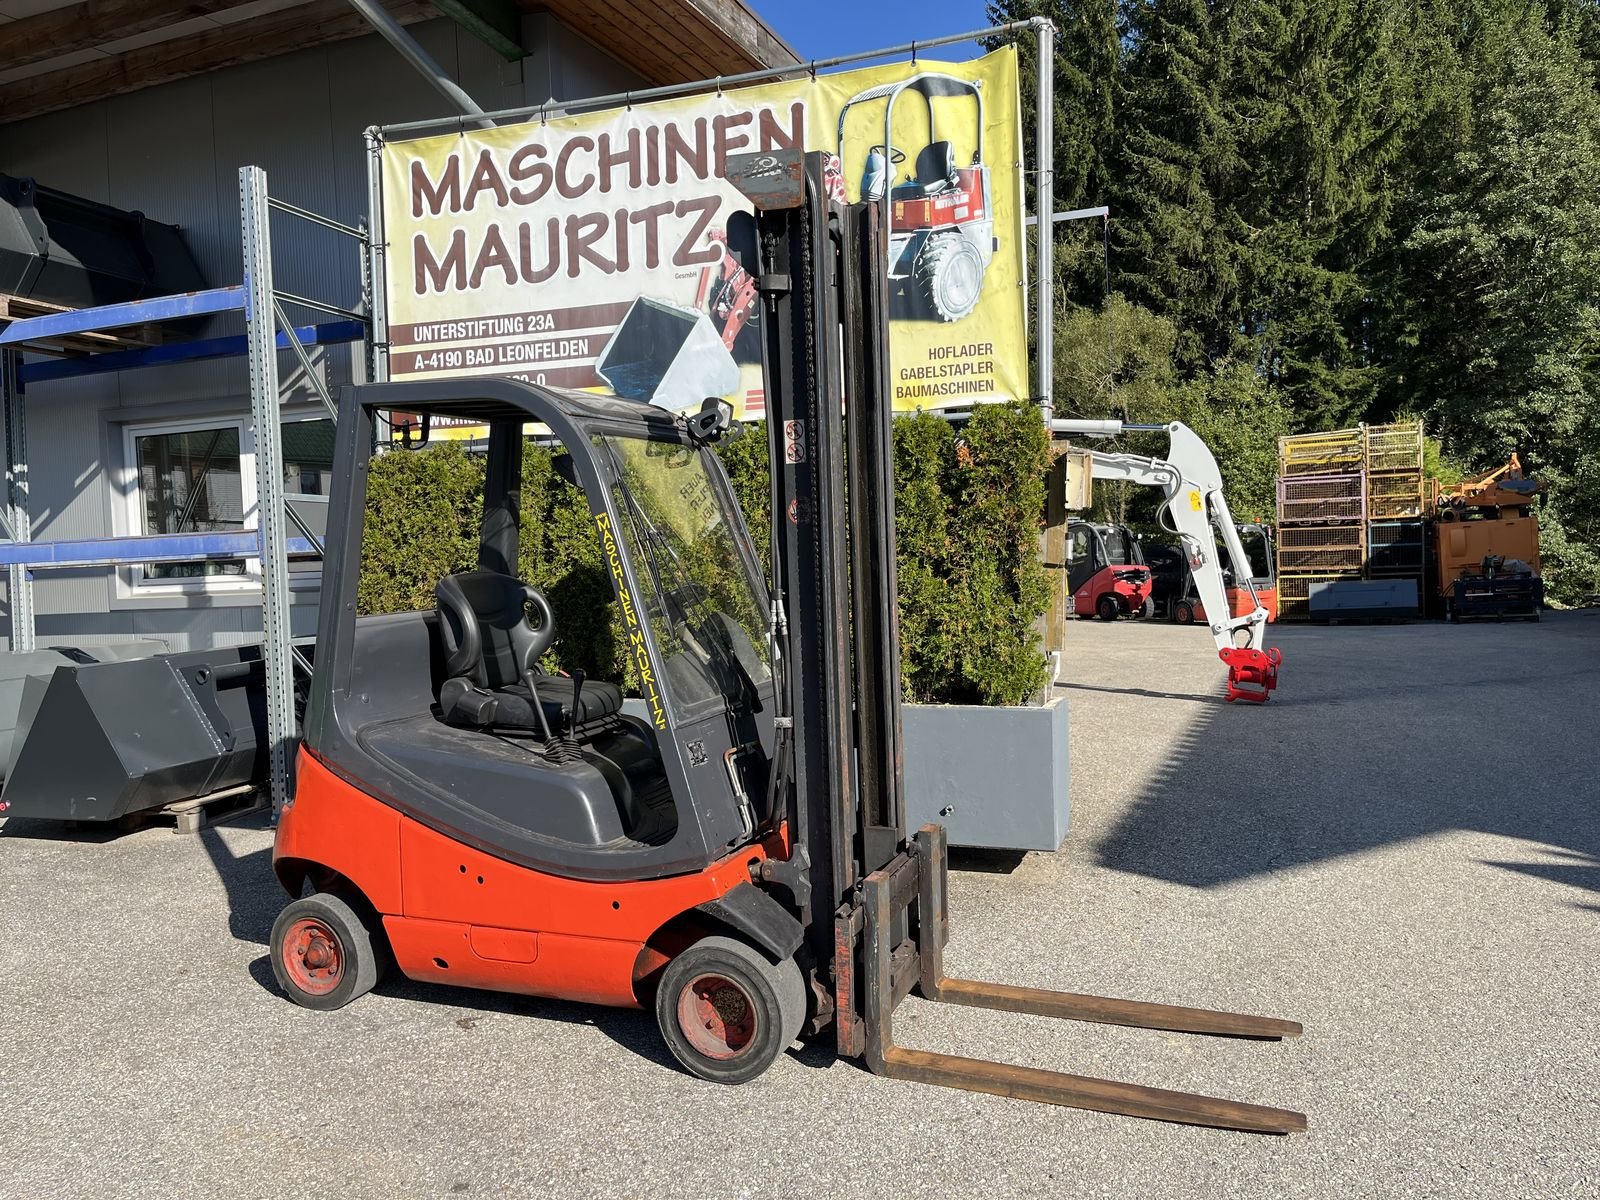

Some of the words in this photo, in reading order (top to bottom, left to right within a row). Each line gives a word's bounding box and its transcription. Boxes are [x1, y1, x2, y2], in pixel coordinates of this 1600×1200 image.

[411, 102, 805, 218] MASCHINEN
[414, 194, 723, 295] MAURITZ
[413, 316, 524, 342] UNTERSTIFTUNG
[527, 313, 555, 332] 23A
[414, 350, 462, 370] A-4190
[465, 348, 494, 366] BAD
[499, 338, 589, 363] LEONFELDEN
[928, 342, 993, 360] HOFLADER
[900, 360, 994, 381] GABELSTAPLER
[896, 379, 994, 399] BAUMASCHINEN
